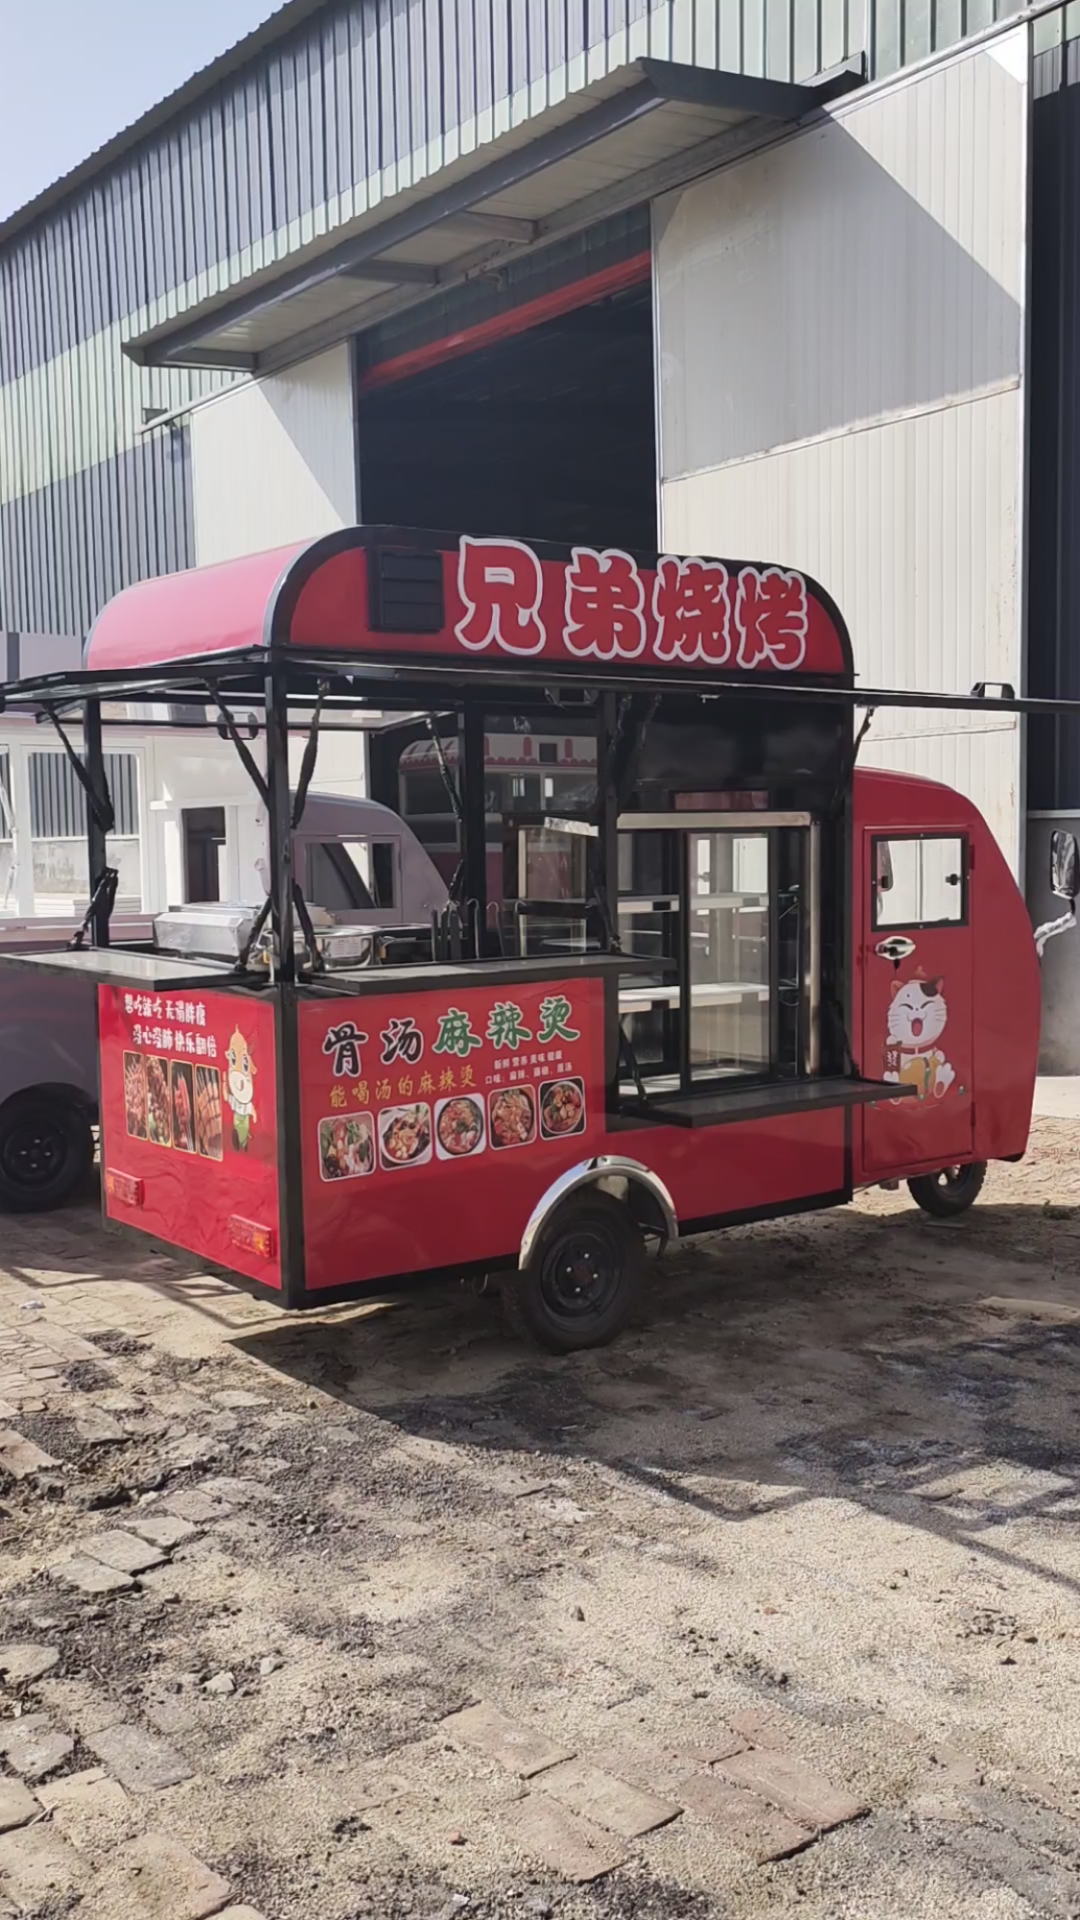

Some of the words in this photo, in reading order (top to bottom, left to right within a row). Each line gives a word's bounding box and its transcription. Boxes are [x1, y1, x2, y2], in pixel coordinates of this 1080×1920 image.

[454, 535, 809, 671] 兄弟烧烤
[322, 995, 581, 1077] 骨汤麻辣烫
[329, 1064, 477, 1108] 能喝汤的麻辣烫
